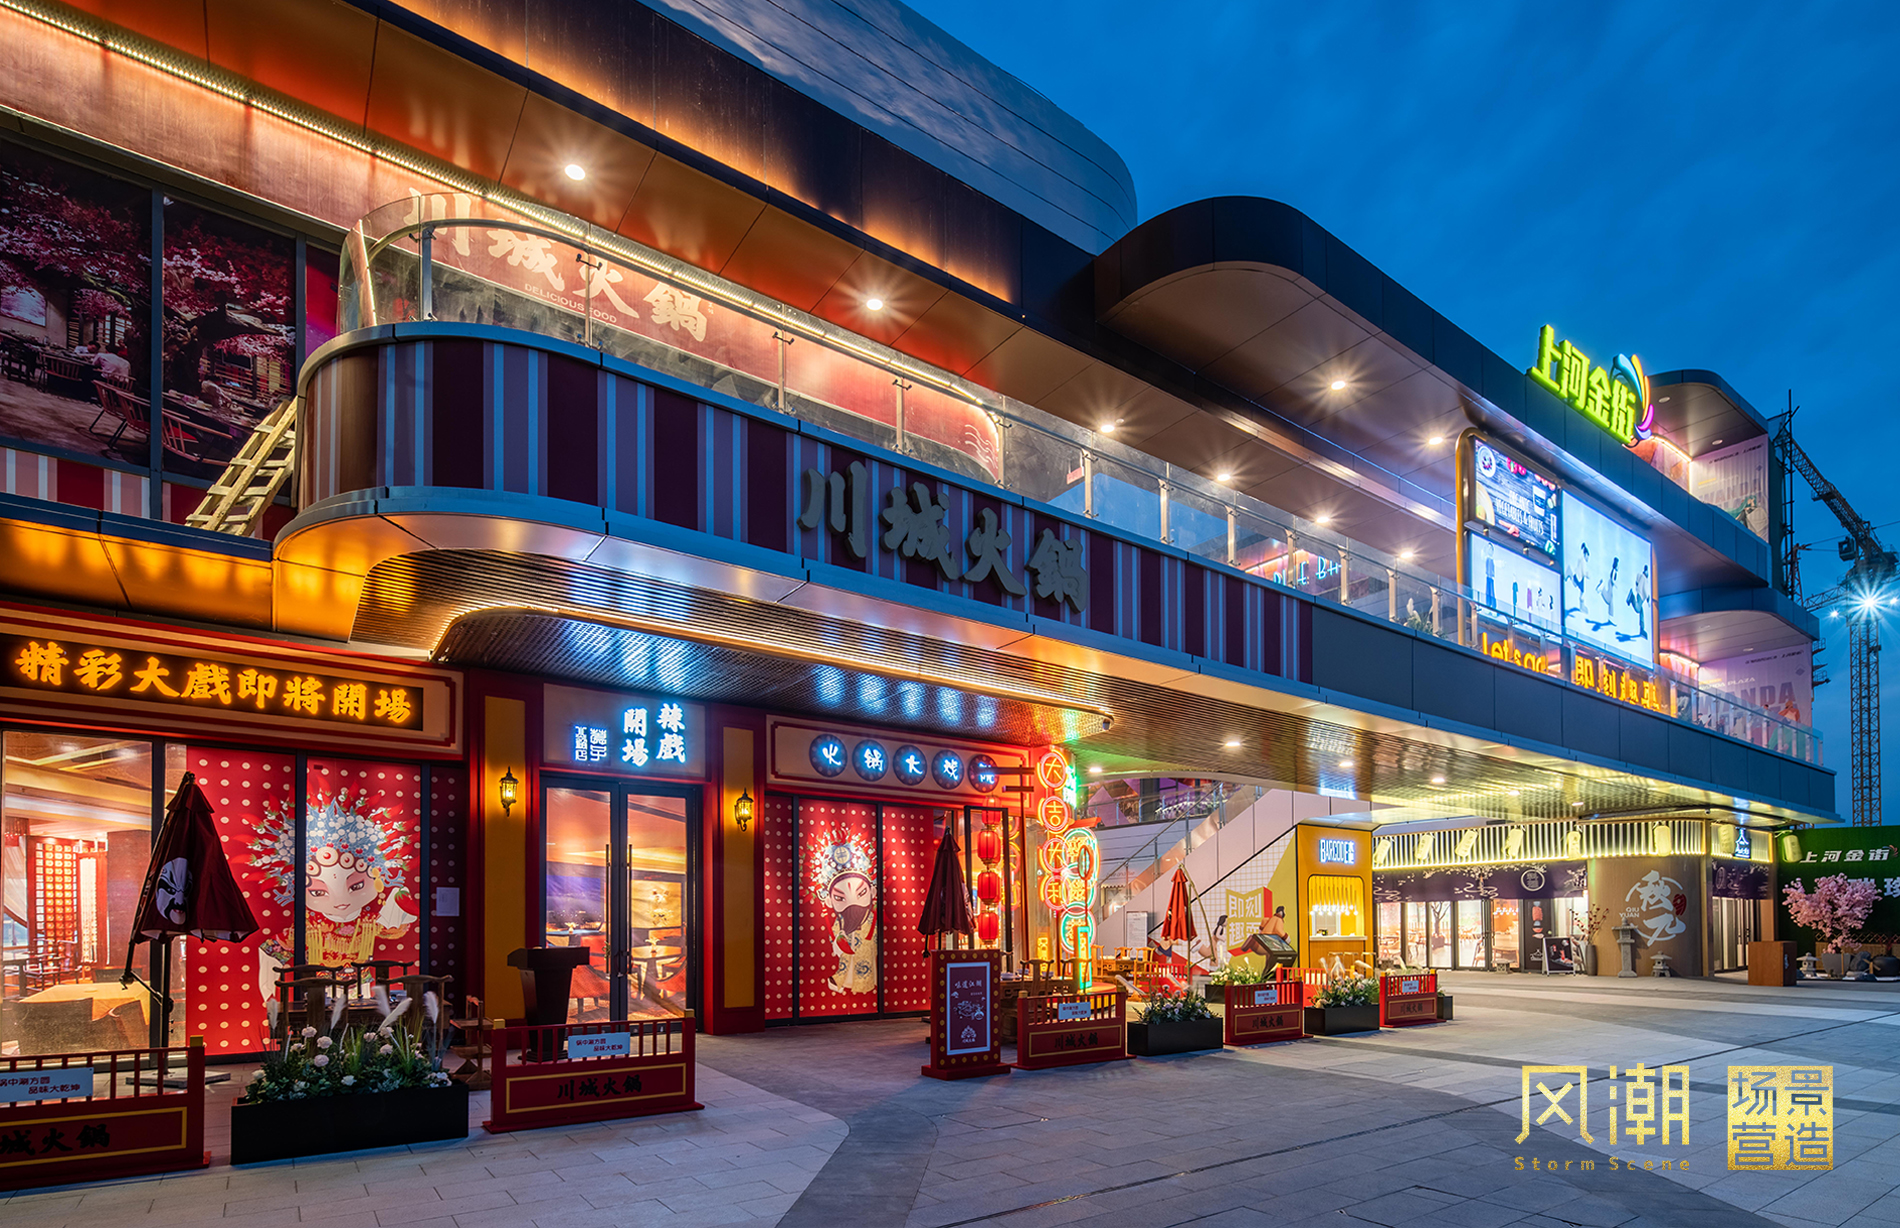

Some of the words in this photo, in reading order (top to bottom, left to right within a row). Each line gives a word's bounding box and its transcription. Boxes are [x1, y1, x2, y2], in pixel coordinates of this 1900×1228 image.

[524, 283, 585, 311] DELICIOUS
[588, 306, 618, 324] FOOD
[1527, 324, 1637, 445] 上河金街
[797, 460, 1088, 614] 川城火鍋
[1727, 677, 1756, 687] PLAZA
[1799, 848, 1890, 864] 上河金街
[1228, 892, 1262, 919] 即刻
[557, 1074, 643, 1101] 川城火鍋
